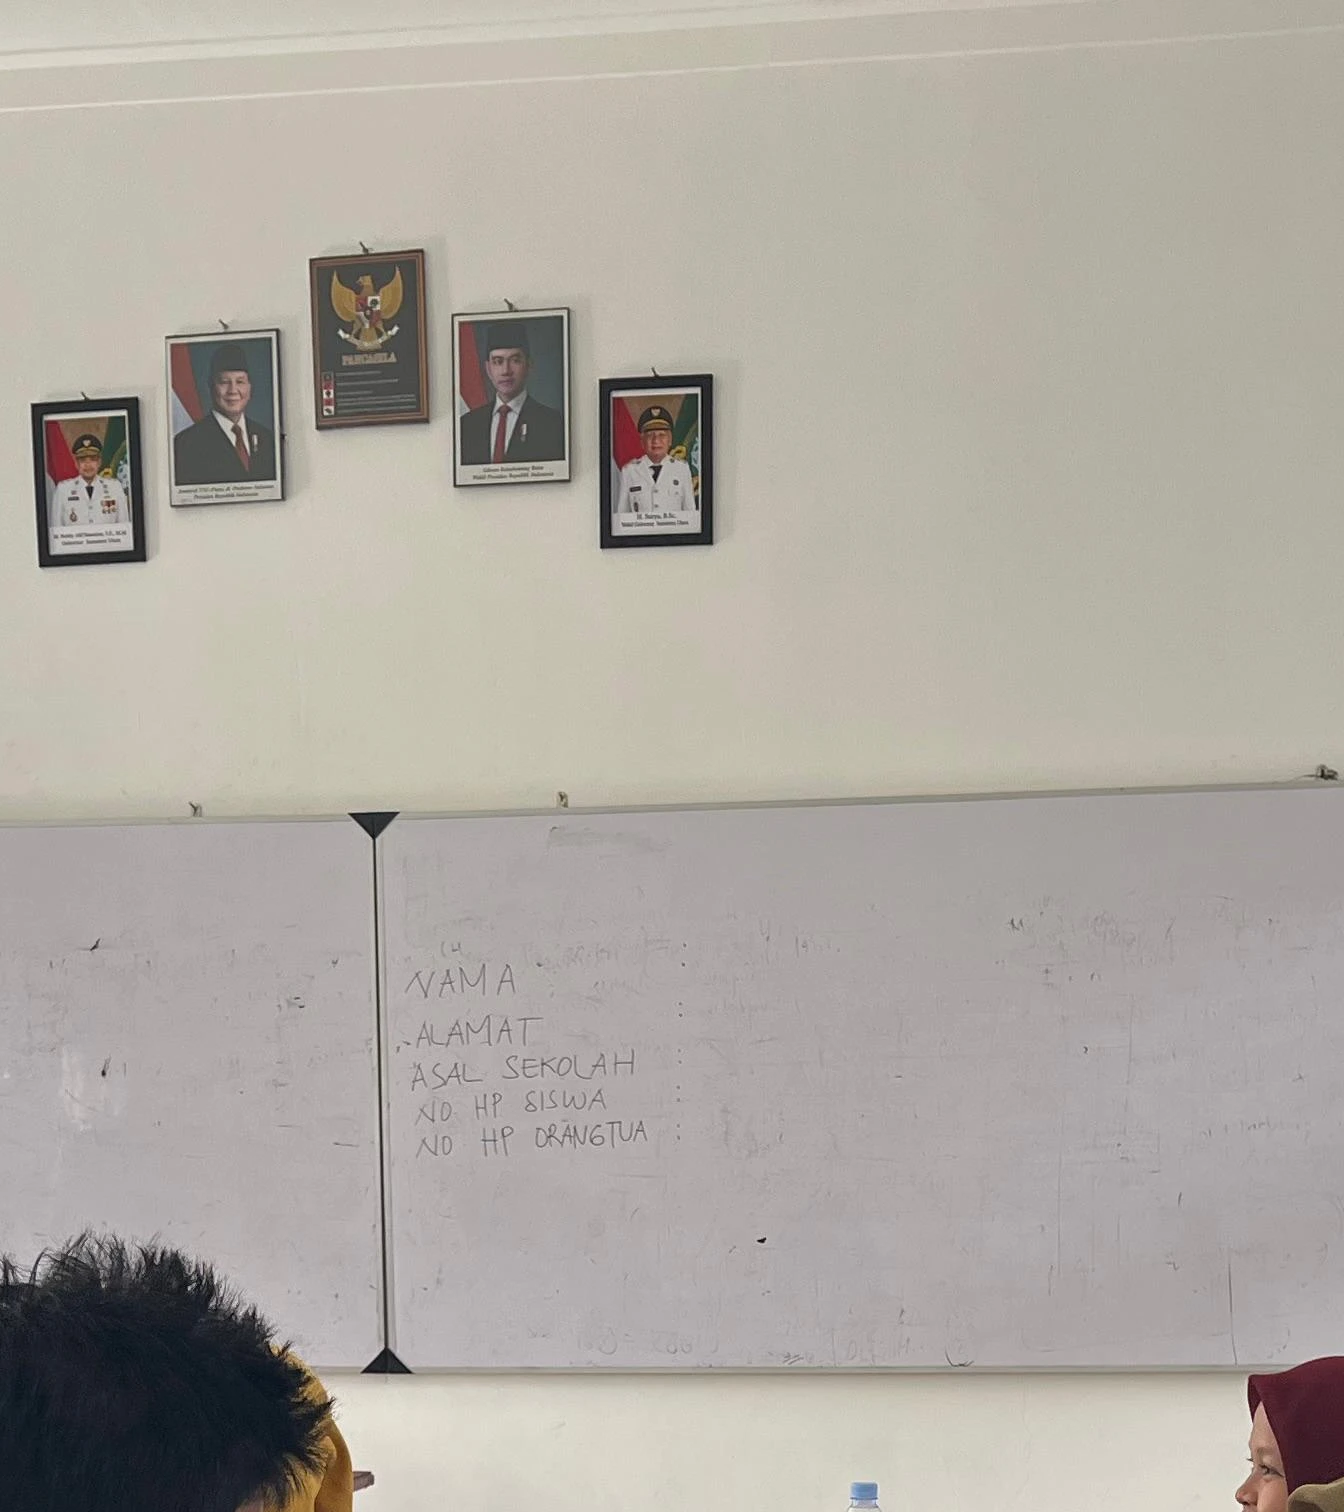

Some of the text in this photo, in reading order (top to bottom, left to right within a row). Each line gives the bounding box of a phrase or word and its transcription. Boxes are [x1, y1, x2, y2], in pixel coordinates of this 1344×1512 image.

[405, 963, 517, 999] NAMA
[415, 1014, 544, 1047] ALAMAT
[411, 1048, 636, 1091] ASAL SEKOLAH
[414, 1088, 607, 1126] NO HP SISWA
[416, 1120, 648, 1159] NO HP ORANGTUA
